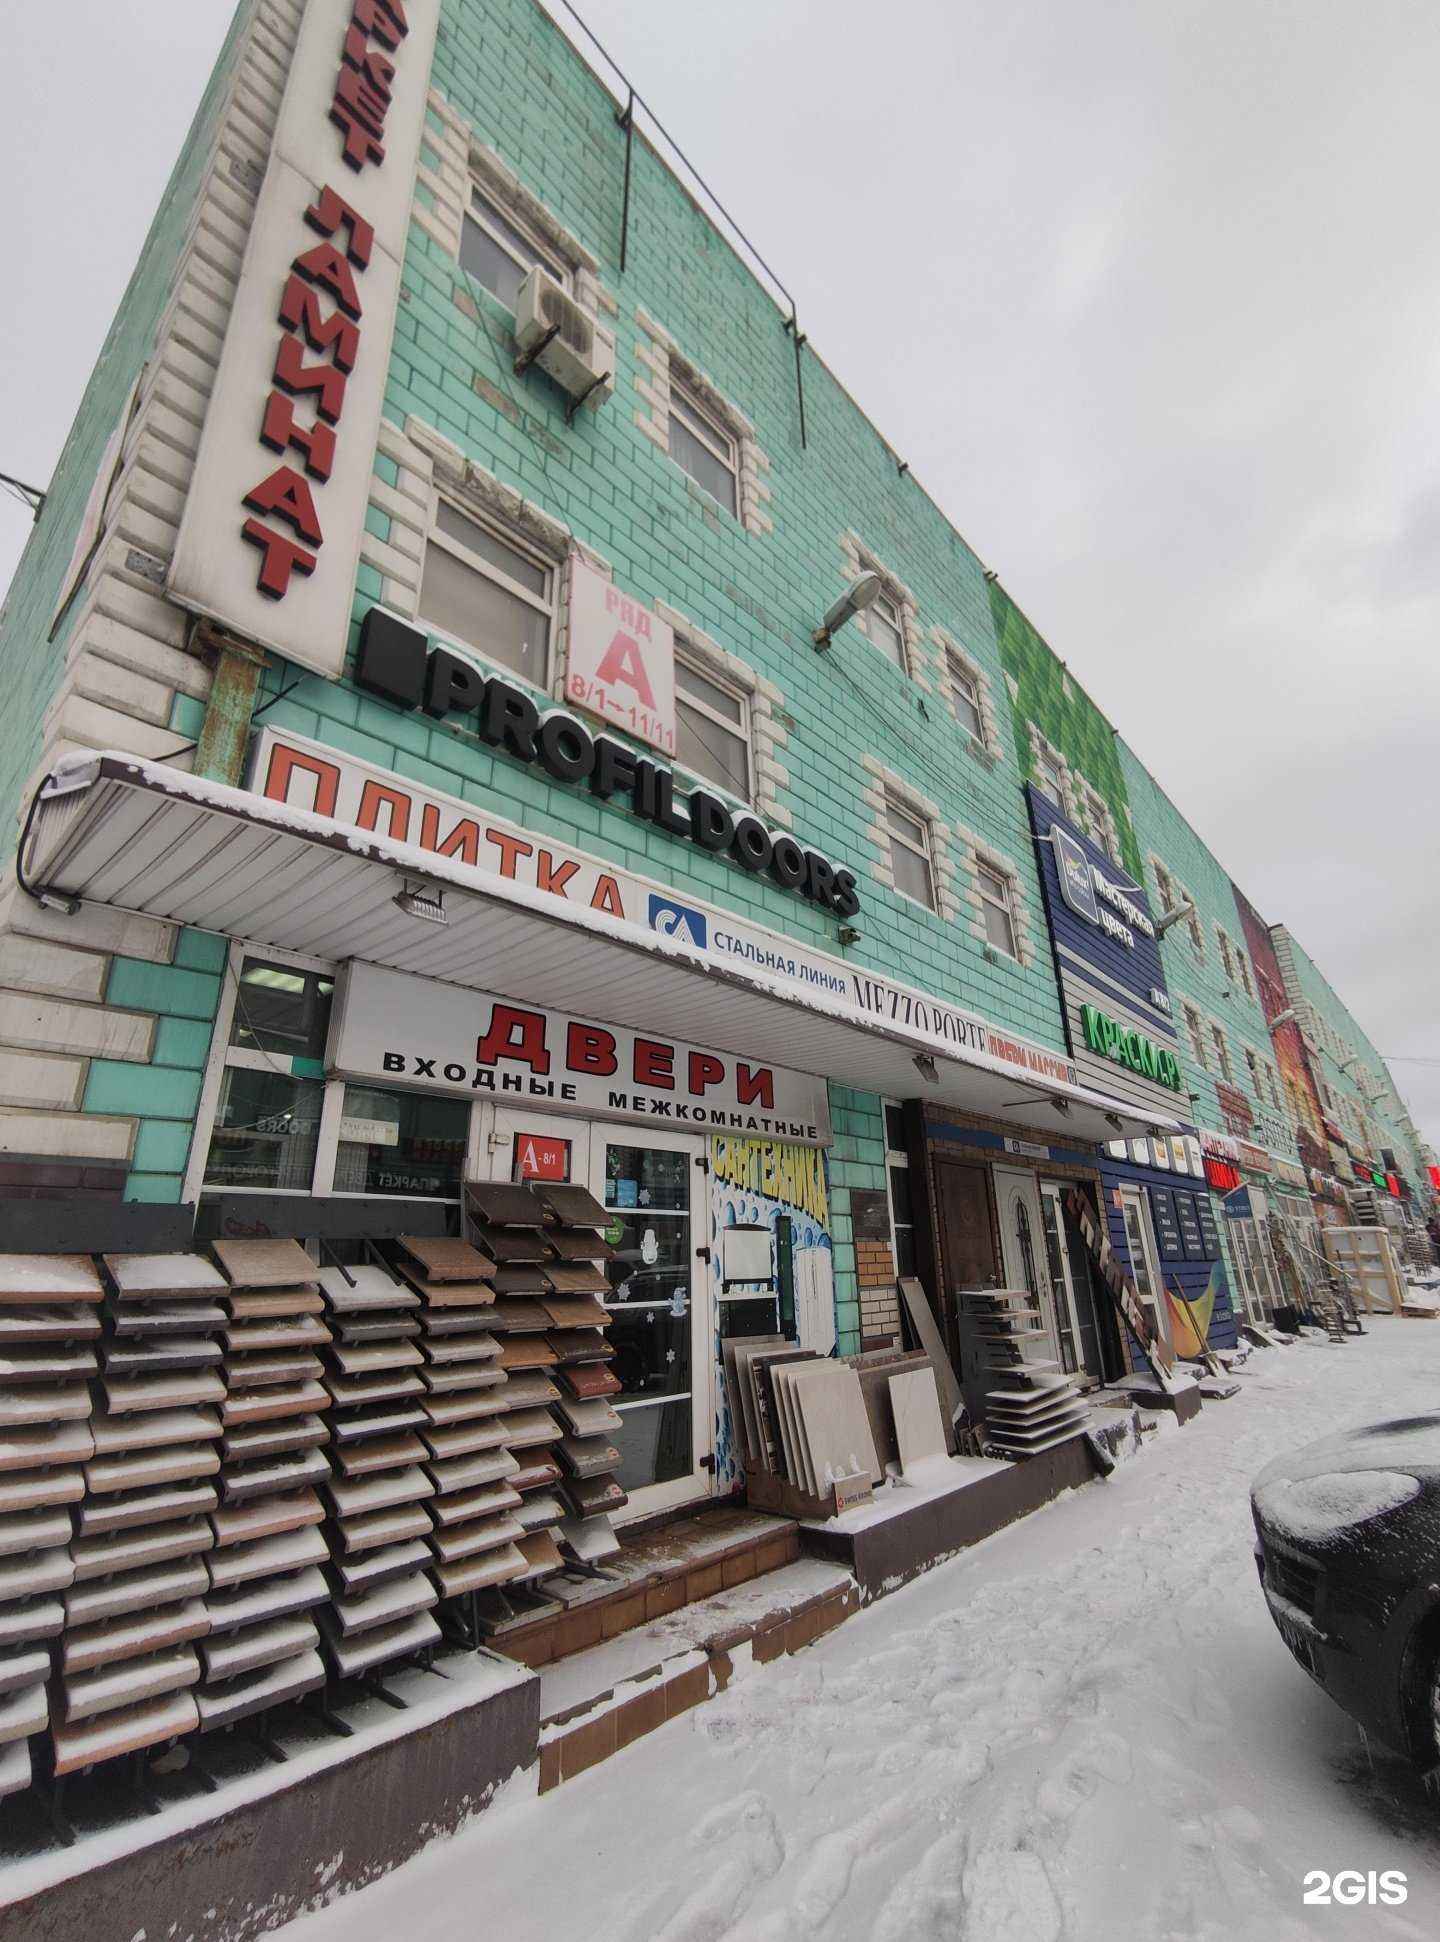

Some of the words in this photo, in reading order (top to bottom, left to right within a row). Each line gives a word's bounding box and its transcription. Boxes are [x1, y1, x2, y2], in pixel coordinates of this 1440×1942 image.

[241, 184, 375, 601] ЛАМИНАТ
[605, 588, 653, 643] РЯД
[595, 629, 657, 712] А
[421, 645, 862, 919] PROFILDOORS
[713, 931, 795, 977] СТАЛЬНАЯ
[800, 964, 846, 994] ЛИНИЯ
[383, 1051, 578, 1102] ВХОДНЫЕ
[608, 1090, 819, 1140] МЕЖКОМНАТНЫЕ
[477, 1002, 776, 1110] ДВЕРИ
